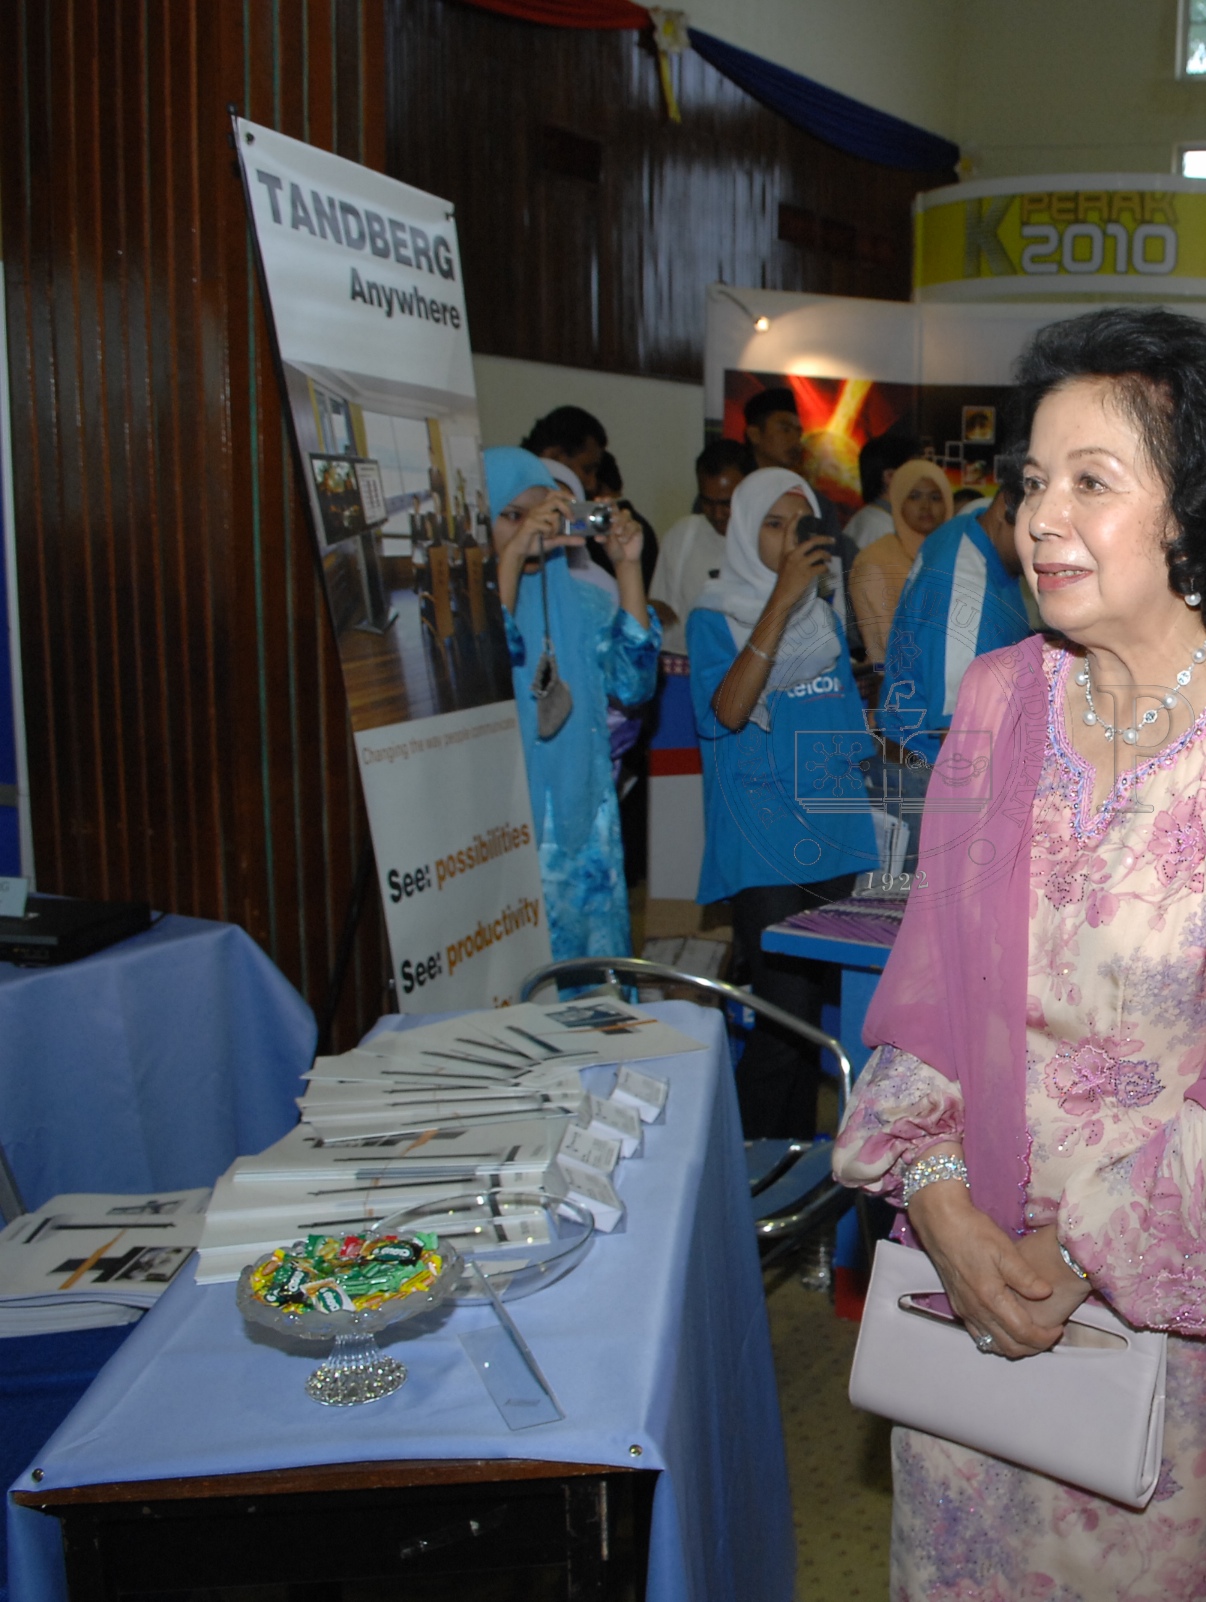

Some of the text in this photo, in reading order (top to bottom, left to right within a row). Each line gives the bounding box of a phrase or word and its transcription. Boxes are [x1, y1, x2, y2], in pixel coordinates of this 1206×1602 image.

[256, 169, 455, 282] TANDBERG
[1020, 190, 1179, 224] PERAK
[1021, 222, 1178, 275] 2010
[351, 266, 461, 329] Anywhere
[362, 741, 409, 765] Changing
[409, 737, 424, 754] the
[387, 822, 531, 903] See: possibilities
[401, 897, 540, 994] See: productivity
